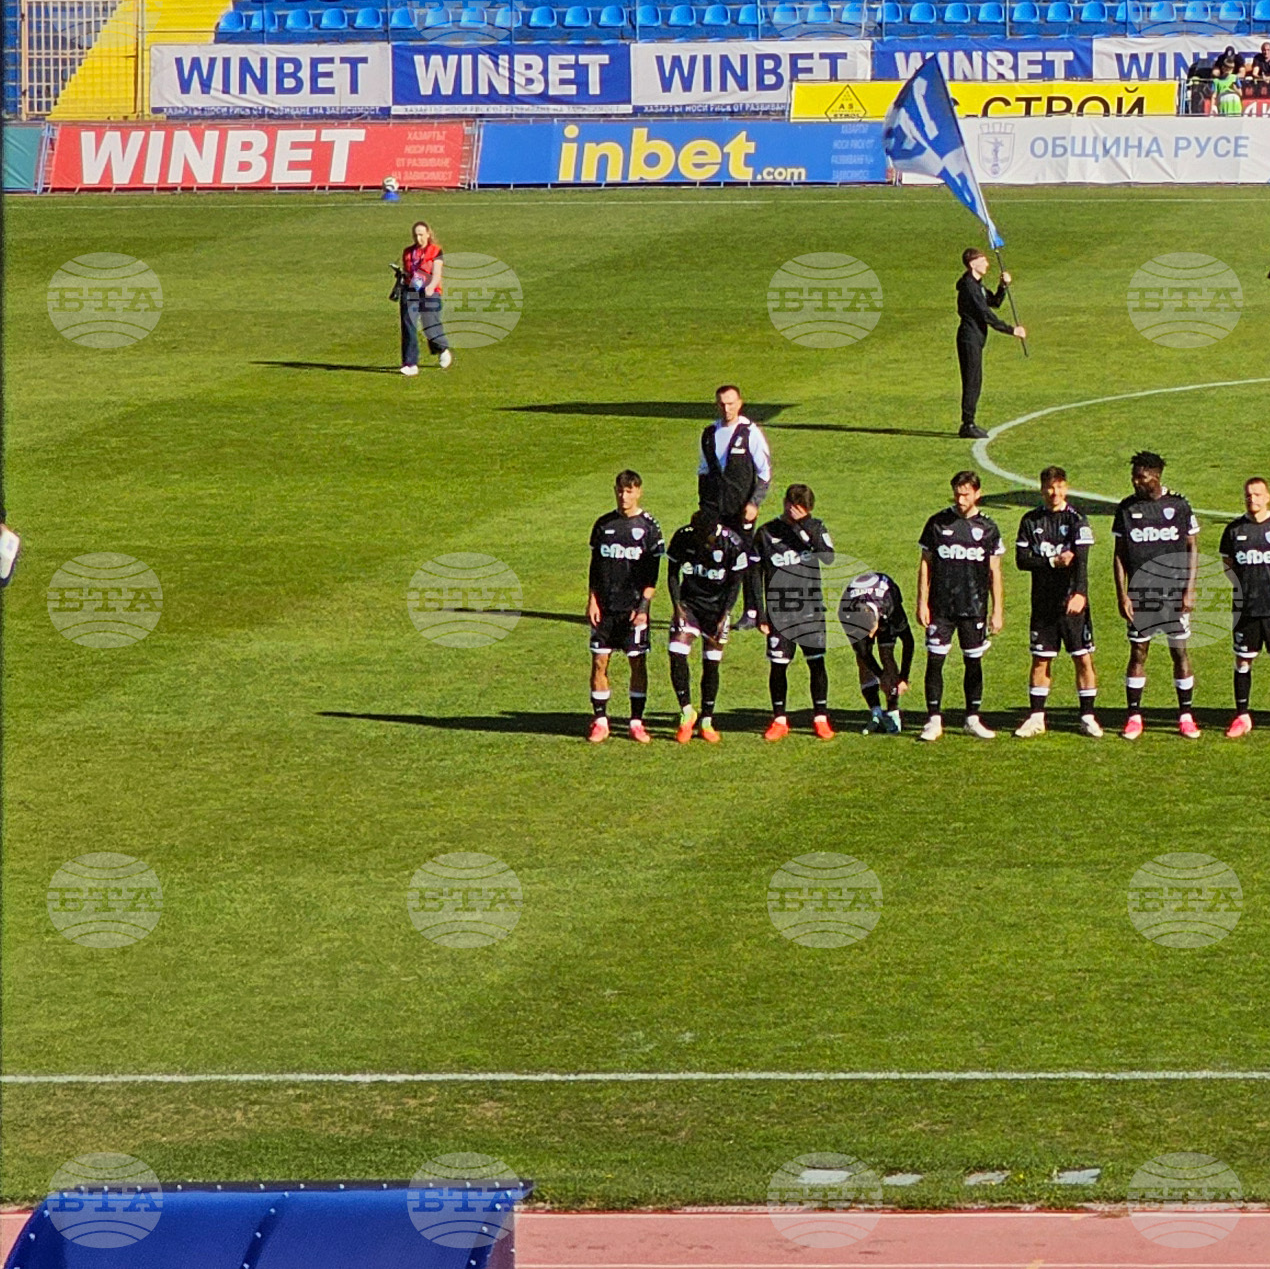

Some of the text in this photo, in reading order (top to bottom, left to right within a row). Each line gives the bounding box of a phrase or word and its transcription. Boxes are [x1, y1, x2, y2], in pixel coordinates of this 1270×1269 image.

[174, 55, 368, 96] WINBET
[413, 54, 610, 96] WINBET
[655, 52, 848, 95] WINBET
[80, 128, 366, 184] WINBET
[1029, 134, 1250, 162] ОБЩИНА РУСЕ
[937, 543, 985, 562] efbet
[1130, 525, 1180, 542] efbet
